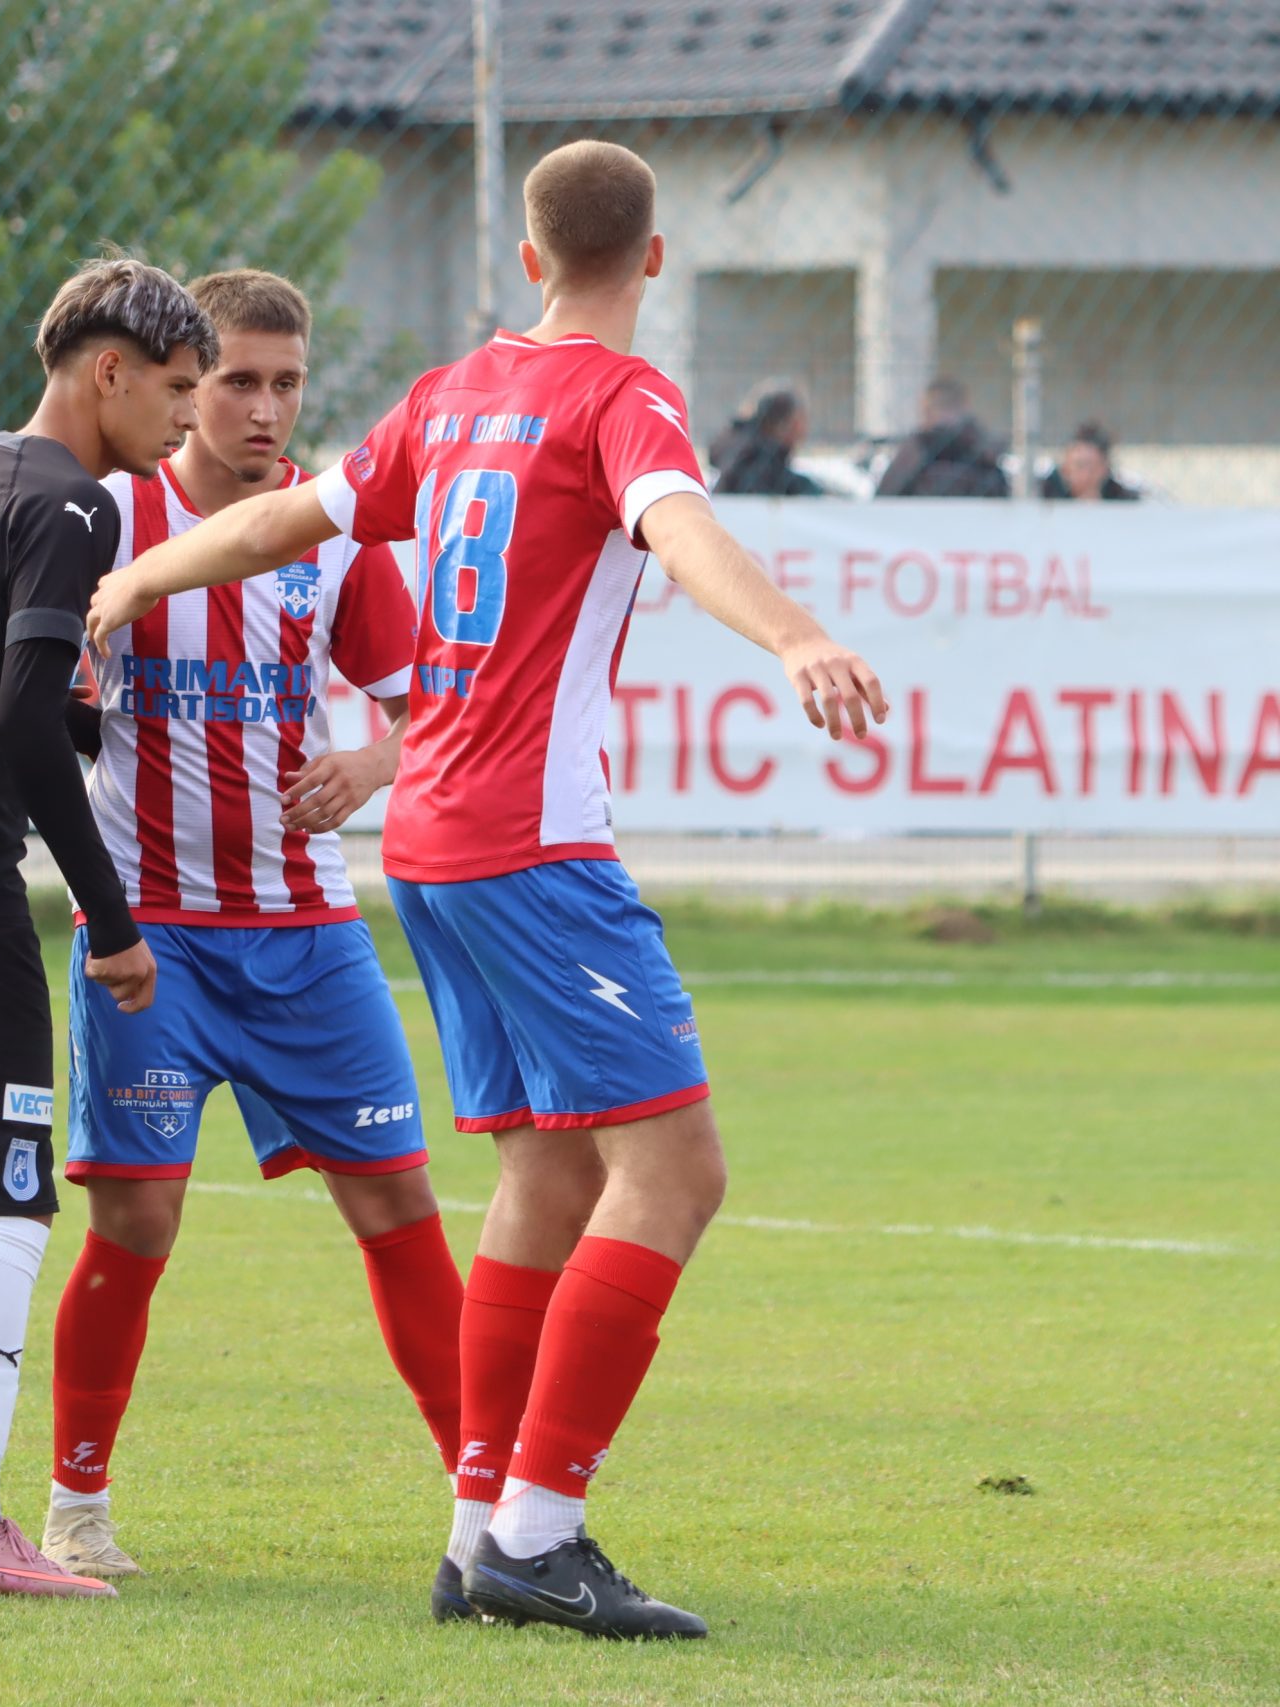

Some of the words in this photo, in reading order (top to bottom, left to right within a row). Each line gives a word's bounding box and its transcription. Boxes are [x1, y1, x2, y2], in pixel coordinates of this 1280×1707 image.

[414, 469, 517, 646] 18
[841, 552, 1109, 618] FOTBAL
[824, 686, 1280, 798] SLATINA
[136, 1088, 156, 1099] BIT
[354, 1102, 414, 1128] Zeus
[61, 1456, 105, 1474] ZEUS
[457, 1464, 496, 1479] EUS
